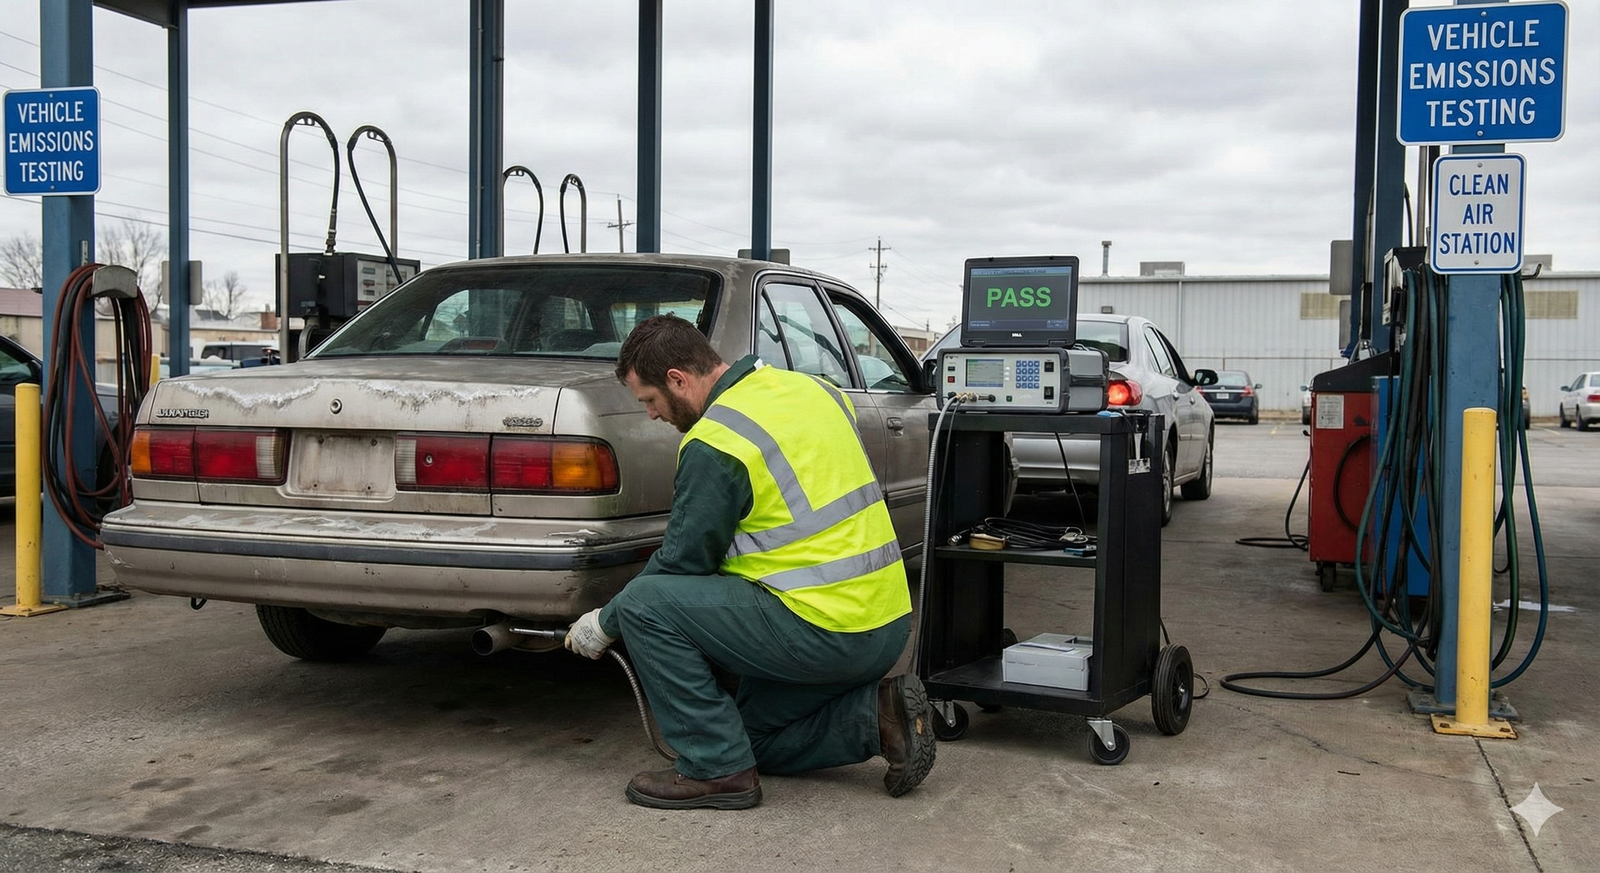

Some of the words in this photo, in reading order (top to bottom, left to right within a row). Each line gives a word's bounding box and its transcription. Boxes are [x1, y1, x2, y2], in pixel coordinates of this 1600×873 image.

[1427, 19, 1540, 51] VEHICLE
[1409, 57, 1556, 90] EMISSIONS
[17, 101, 84, 123] VEHICLE
[1426, 97, 1536, 127] TESTING
[9, 130, 94, 153] EMISSIONS
[20, 160, 84, 182] TESTING
[1449, 173, 1509, 196] CLEAN
[1462, 203, 1494, 225] AIR
[1439, 232, 1515, 254] STATION
[987, 286, 1052, 308] PASS
